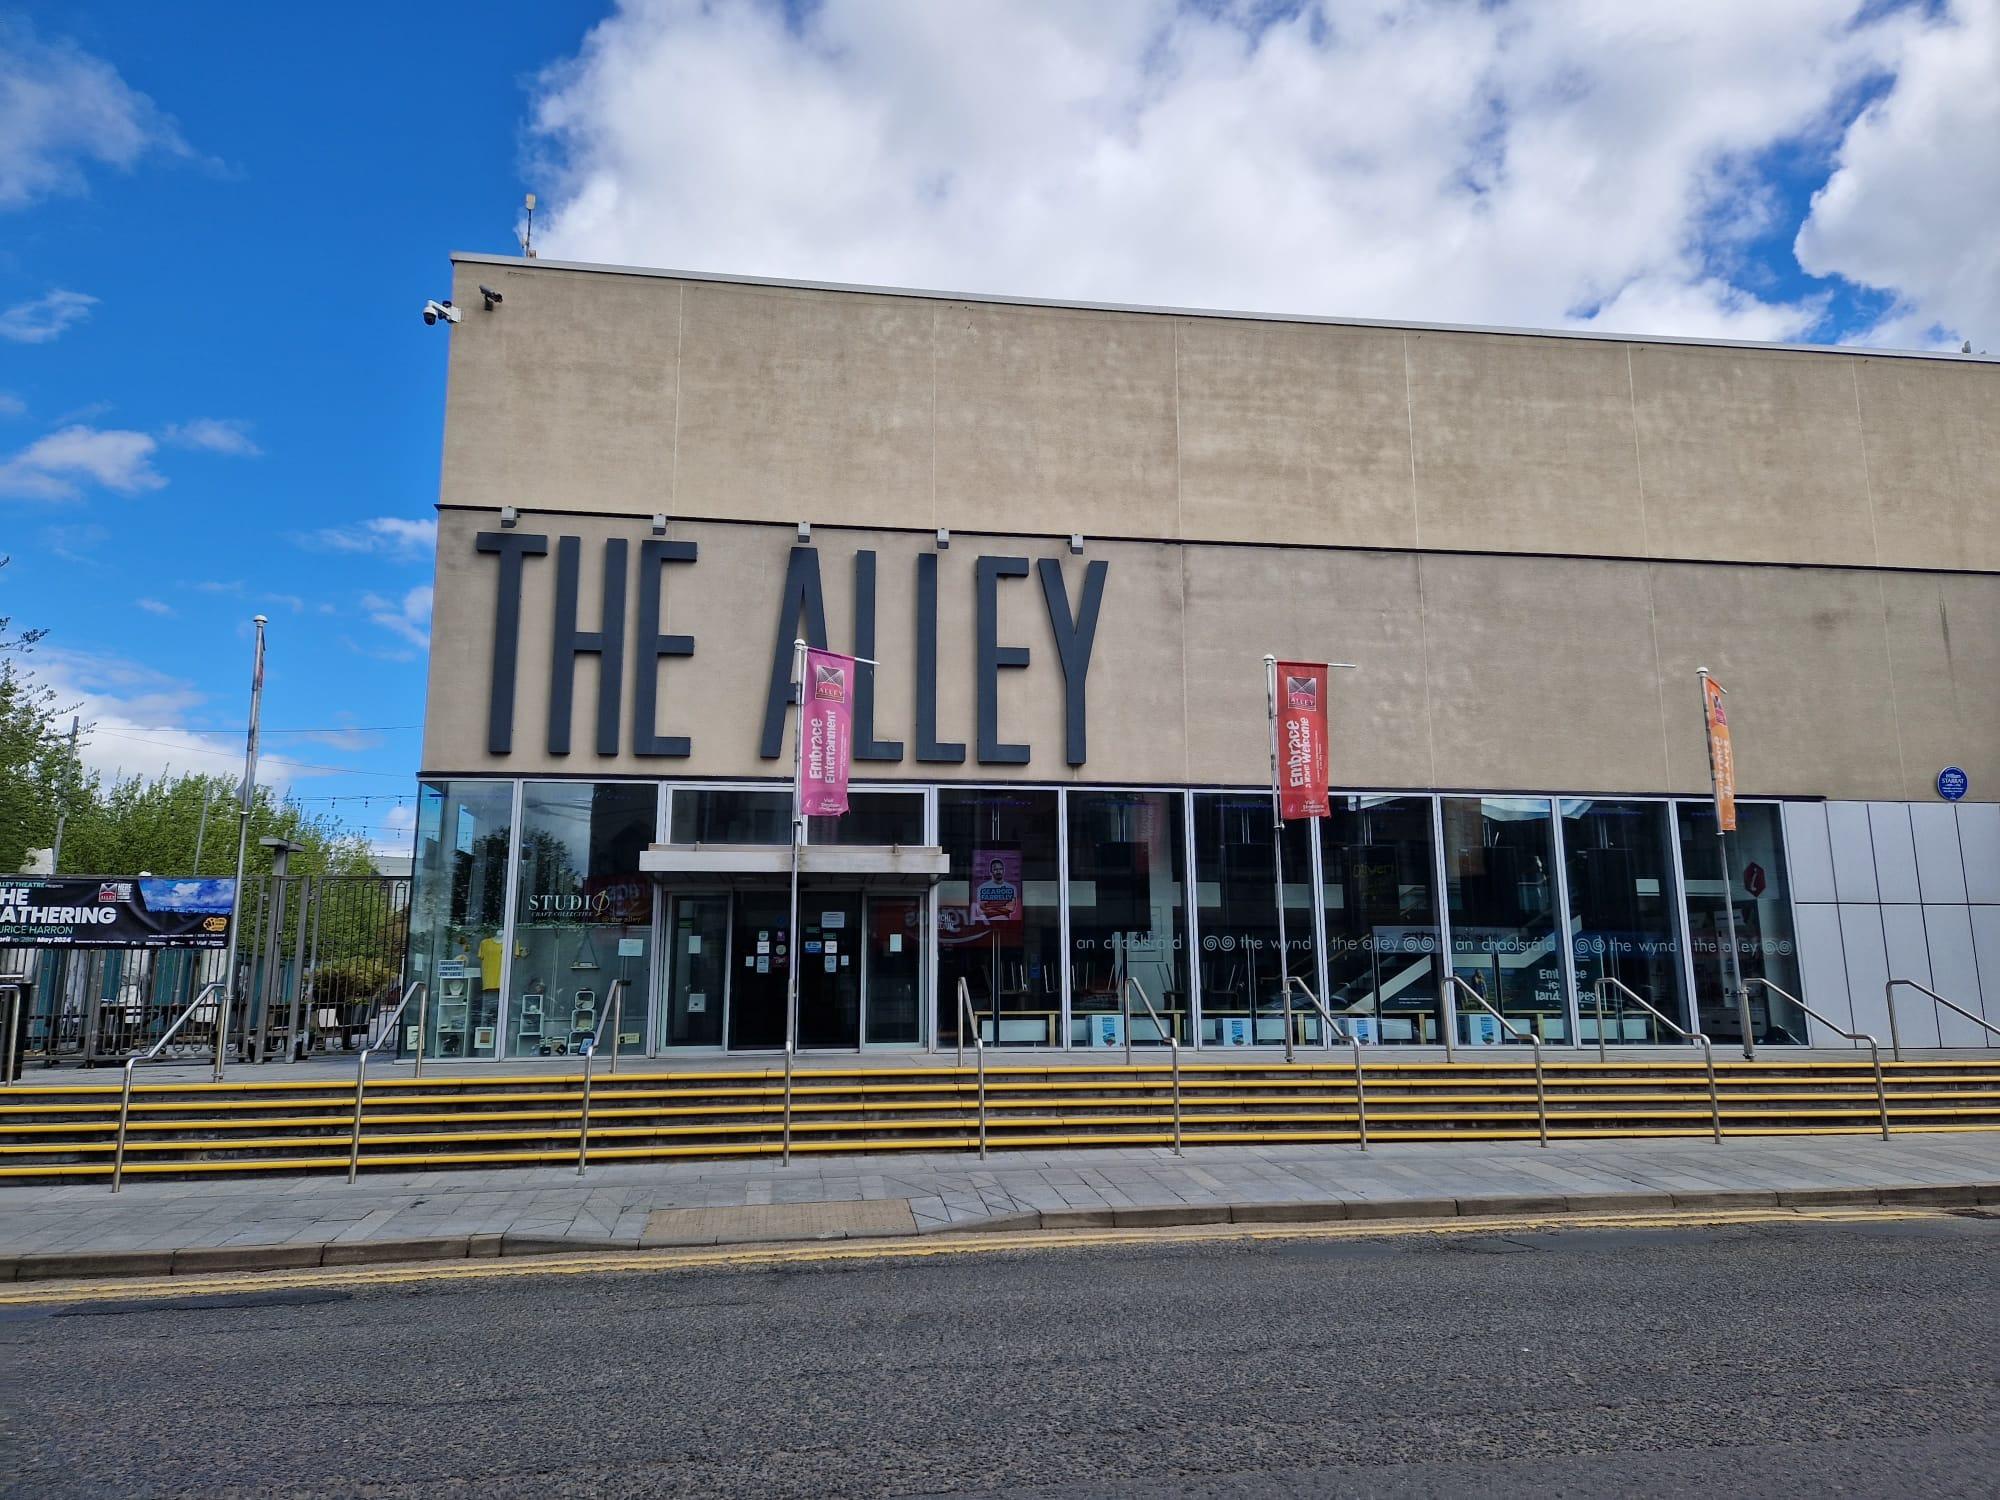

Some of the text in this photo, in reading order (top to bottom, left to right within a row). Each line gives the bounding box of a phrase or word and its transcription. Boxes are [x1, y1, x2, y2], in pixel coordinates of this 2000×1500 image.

[477, 532, 1109, 767] THE ALLEY
[818, 688, 843, 698] ALLEY
[1290, 698, 1315, 706] ALLEY
[809, 718, 823, 780] Embrace
[824, 710, 837, 784] Entertainment
[1300, 717, 1312, 764] Welcome
[1286, 720, 1304, 788] Embrace
[0, 888, 30, 905] HE
[0, 906, 117, 924] ATHERING
[0, 926, 73, 934] URICE HARRON
[36, 936, 54, 944] May
[1076, 938, 1095, 950] an
[1240, 934, 1312, 954] the wynd
[1331, 936, 1399, 953] the alley
[1455, 939, 1474, 951] an
[1609, 937, 1677, 956] the wynd
[1694, 937, 1758, 957] the aley
[1539, 968, 1588, 980] Emce
[1535, 990, 1596, 1002] landpes
